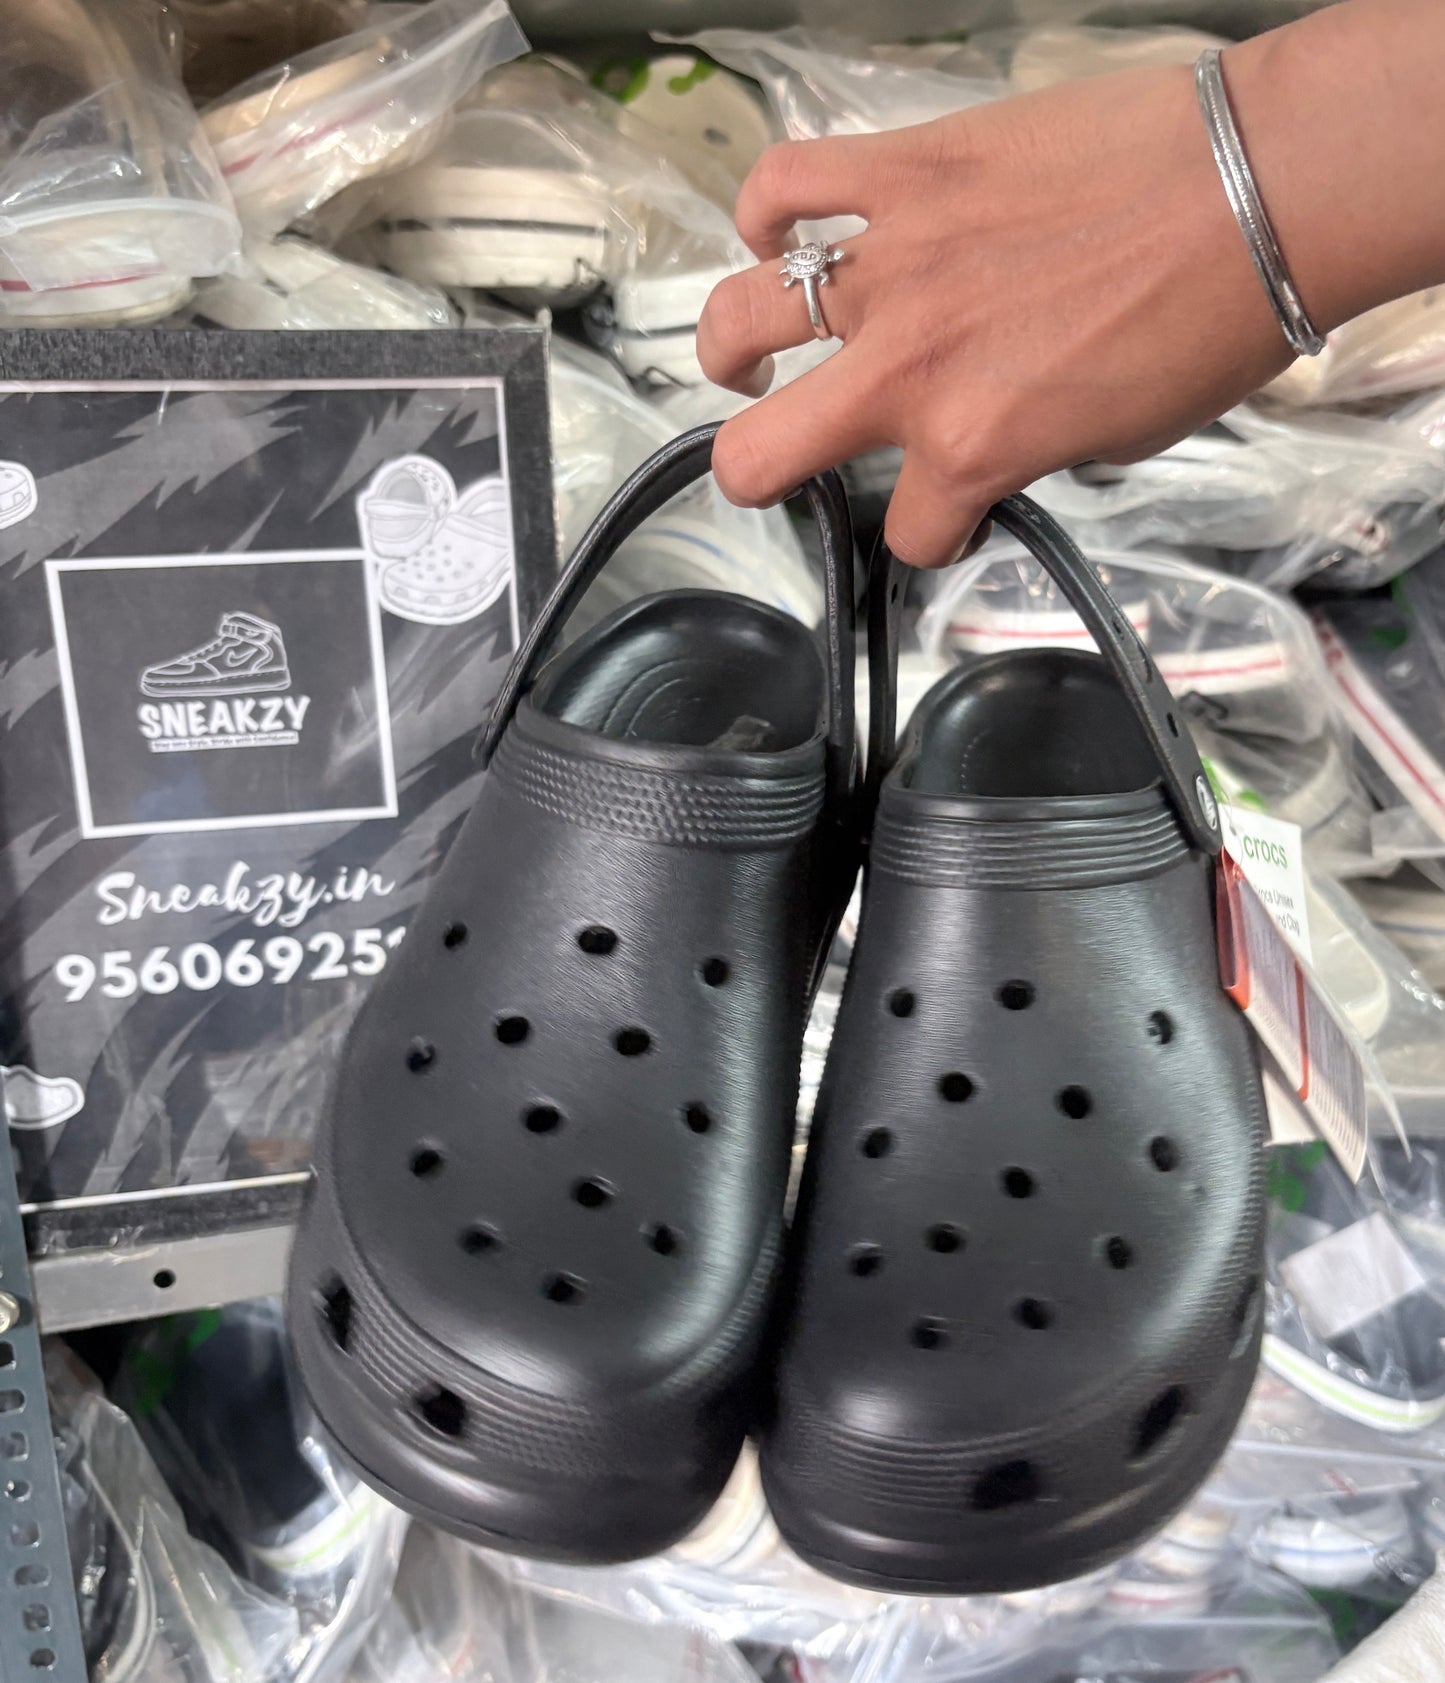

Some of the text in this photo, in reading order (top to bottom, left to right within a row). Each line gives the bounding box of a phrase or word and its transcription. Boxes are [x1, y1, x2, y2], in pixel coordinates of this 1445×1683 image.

[138, 695, 311, 738] SNEAKZY
[1243, 835, 1288, 869] crocs
[97, 861, 396, 927] Sneakzy.in
[55, 926, 406, 1003] 95606925
